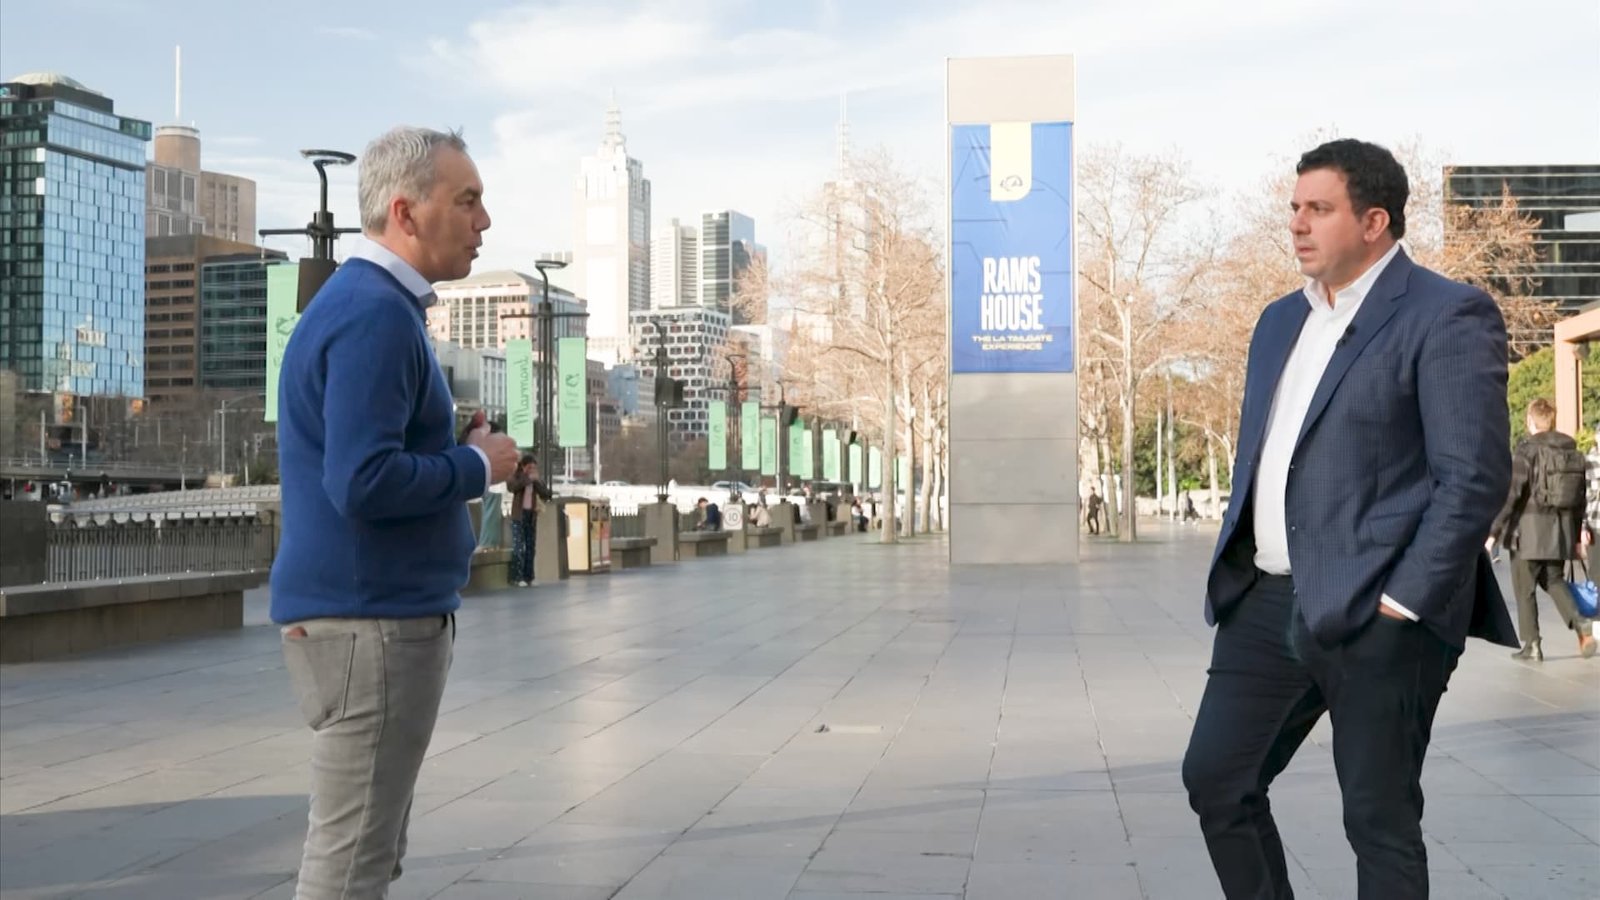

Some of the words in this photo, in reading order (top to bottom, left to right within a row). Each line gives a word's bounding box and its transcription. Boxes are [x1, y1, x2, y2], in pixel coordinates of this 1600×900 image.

[983, 256, 1042, 294] RAMS
[981, 294, 1044, 331] HOUSE
[982, 342, 1043, 351] EXPERIENCE
[1007, 334, 1053, 342] TAILGATE
[512, 356, 529, 430] Marmont
[728, 512, 739, 522] 10
